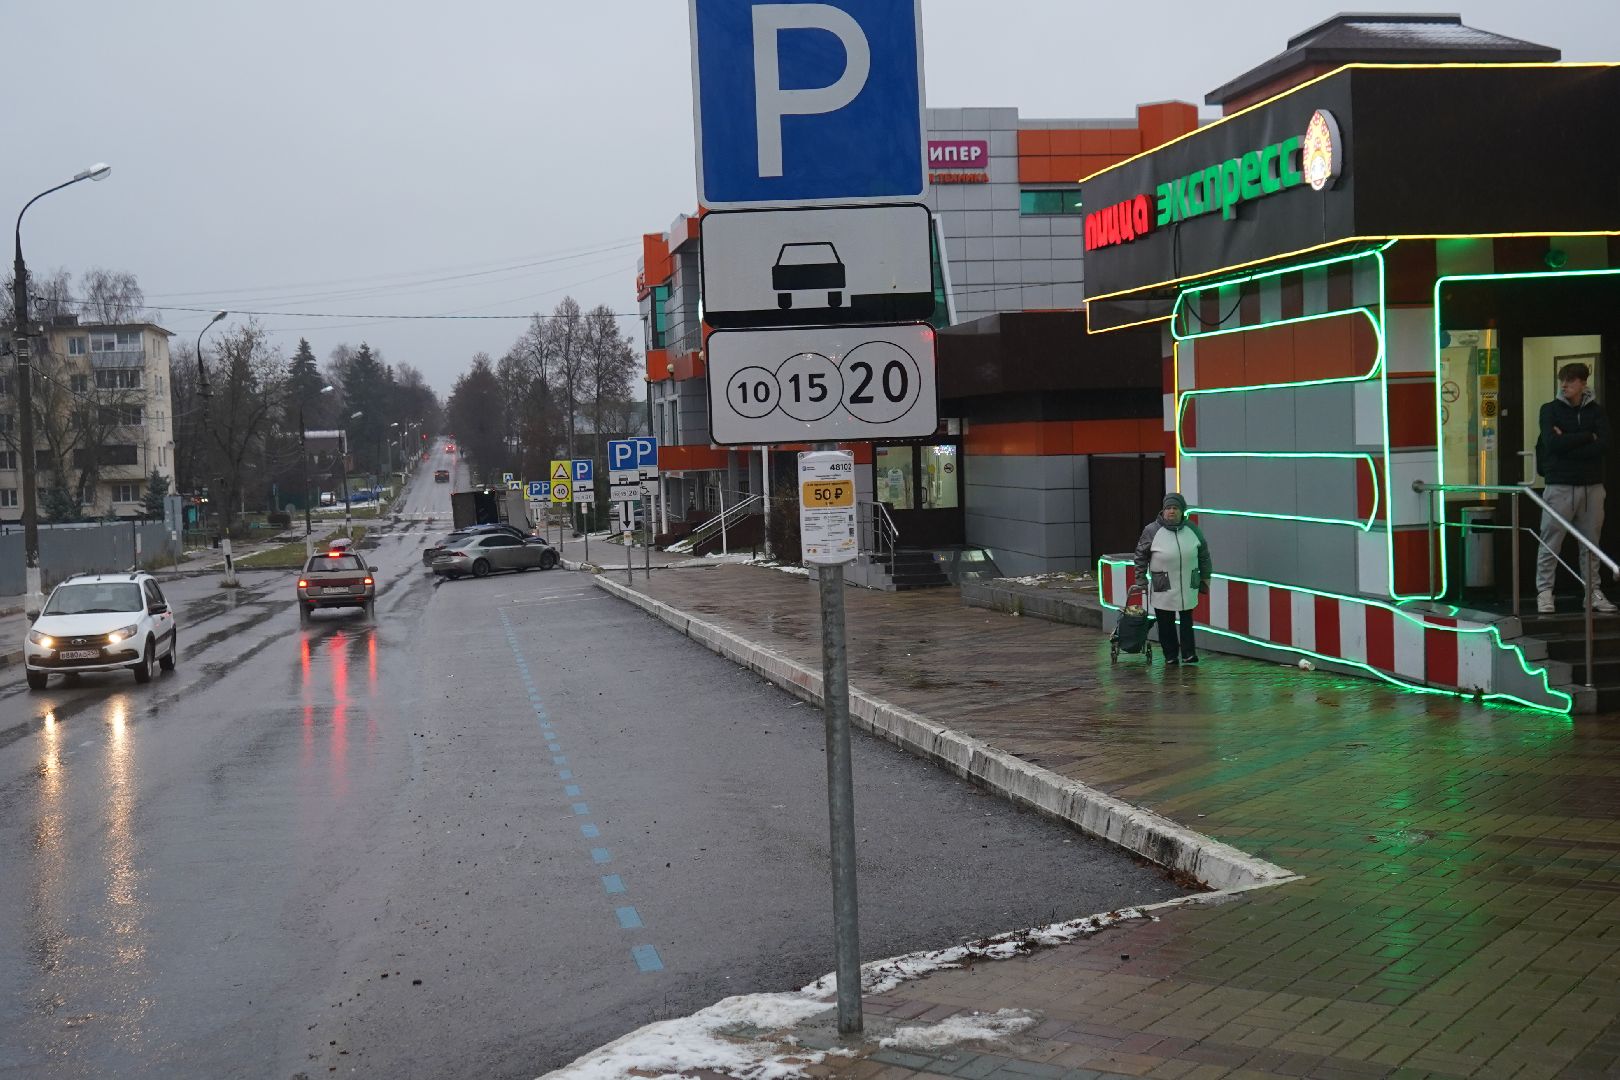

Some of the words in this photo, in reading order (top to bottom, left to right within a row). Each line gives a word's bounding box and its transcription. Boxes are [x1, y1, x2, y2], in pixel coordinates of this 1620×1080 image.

[752, 3, 871, 177] P
[930, 146, 981, 161] ИПЕР
[1156, 136, 1301, 226] экспресс
[737, 381, 770, 404] 10
[788, 373, 828, 402] 15
[849, 360, 908, 404] 20
[616, 444, 631, 467] P
[577, 463, 588, 479] P
[814, 489, 831, 500] 50
